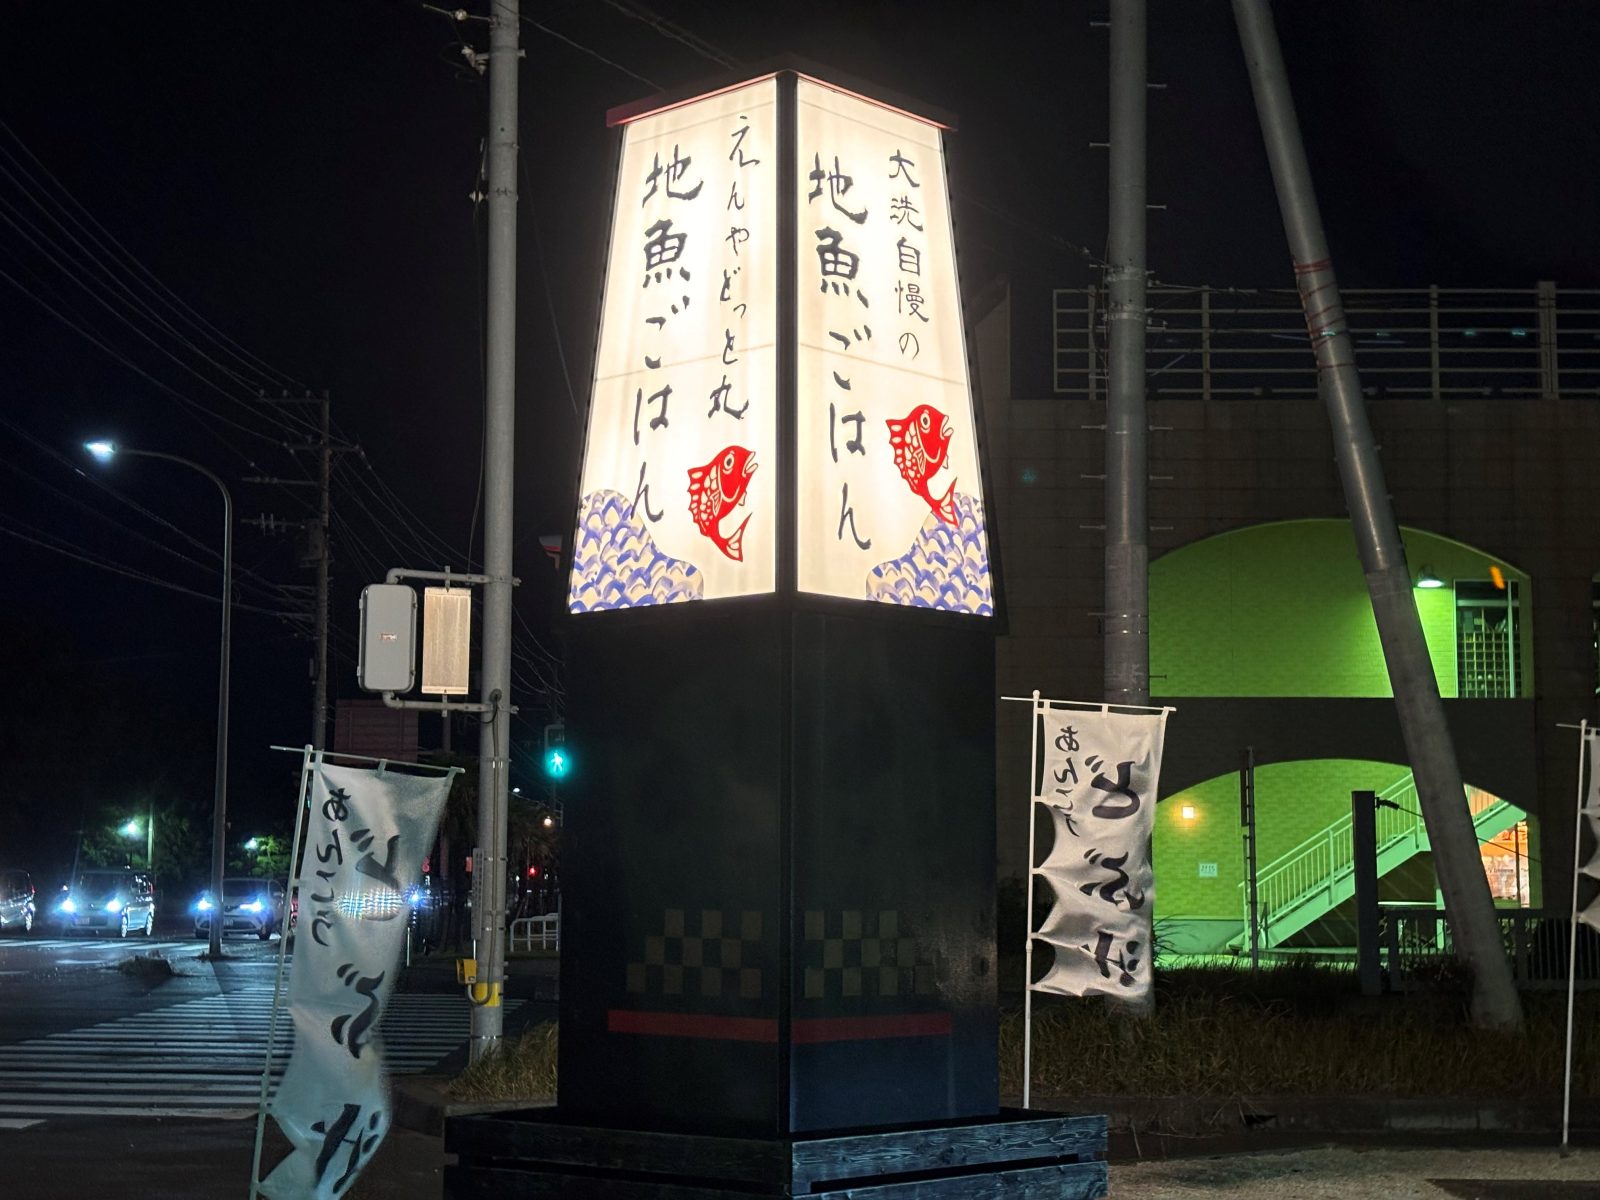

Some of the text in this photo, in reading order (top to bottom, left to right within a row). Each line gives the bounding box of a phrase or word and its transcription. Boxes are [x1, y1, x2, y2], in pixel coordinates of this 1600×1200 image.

[630, 143, 704, 523] 地魚ごはん
[707, 116, 760, 420] えんやどっと丸
[808, 151, 872, 551] 地魚ごはん
[888, 148, 930, 360] 大洗自慢の
